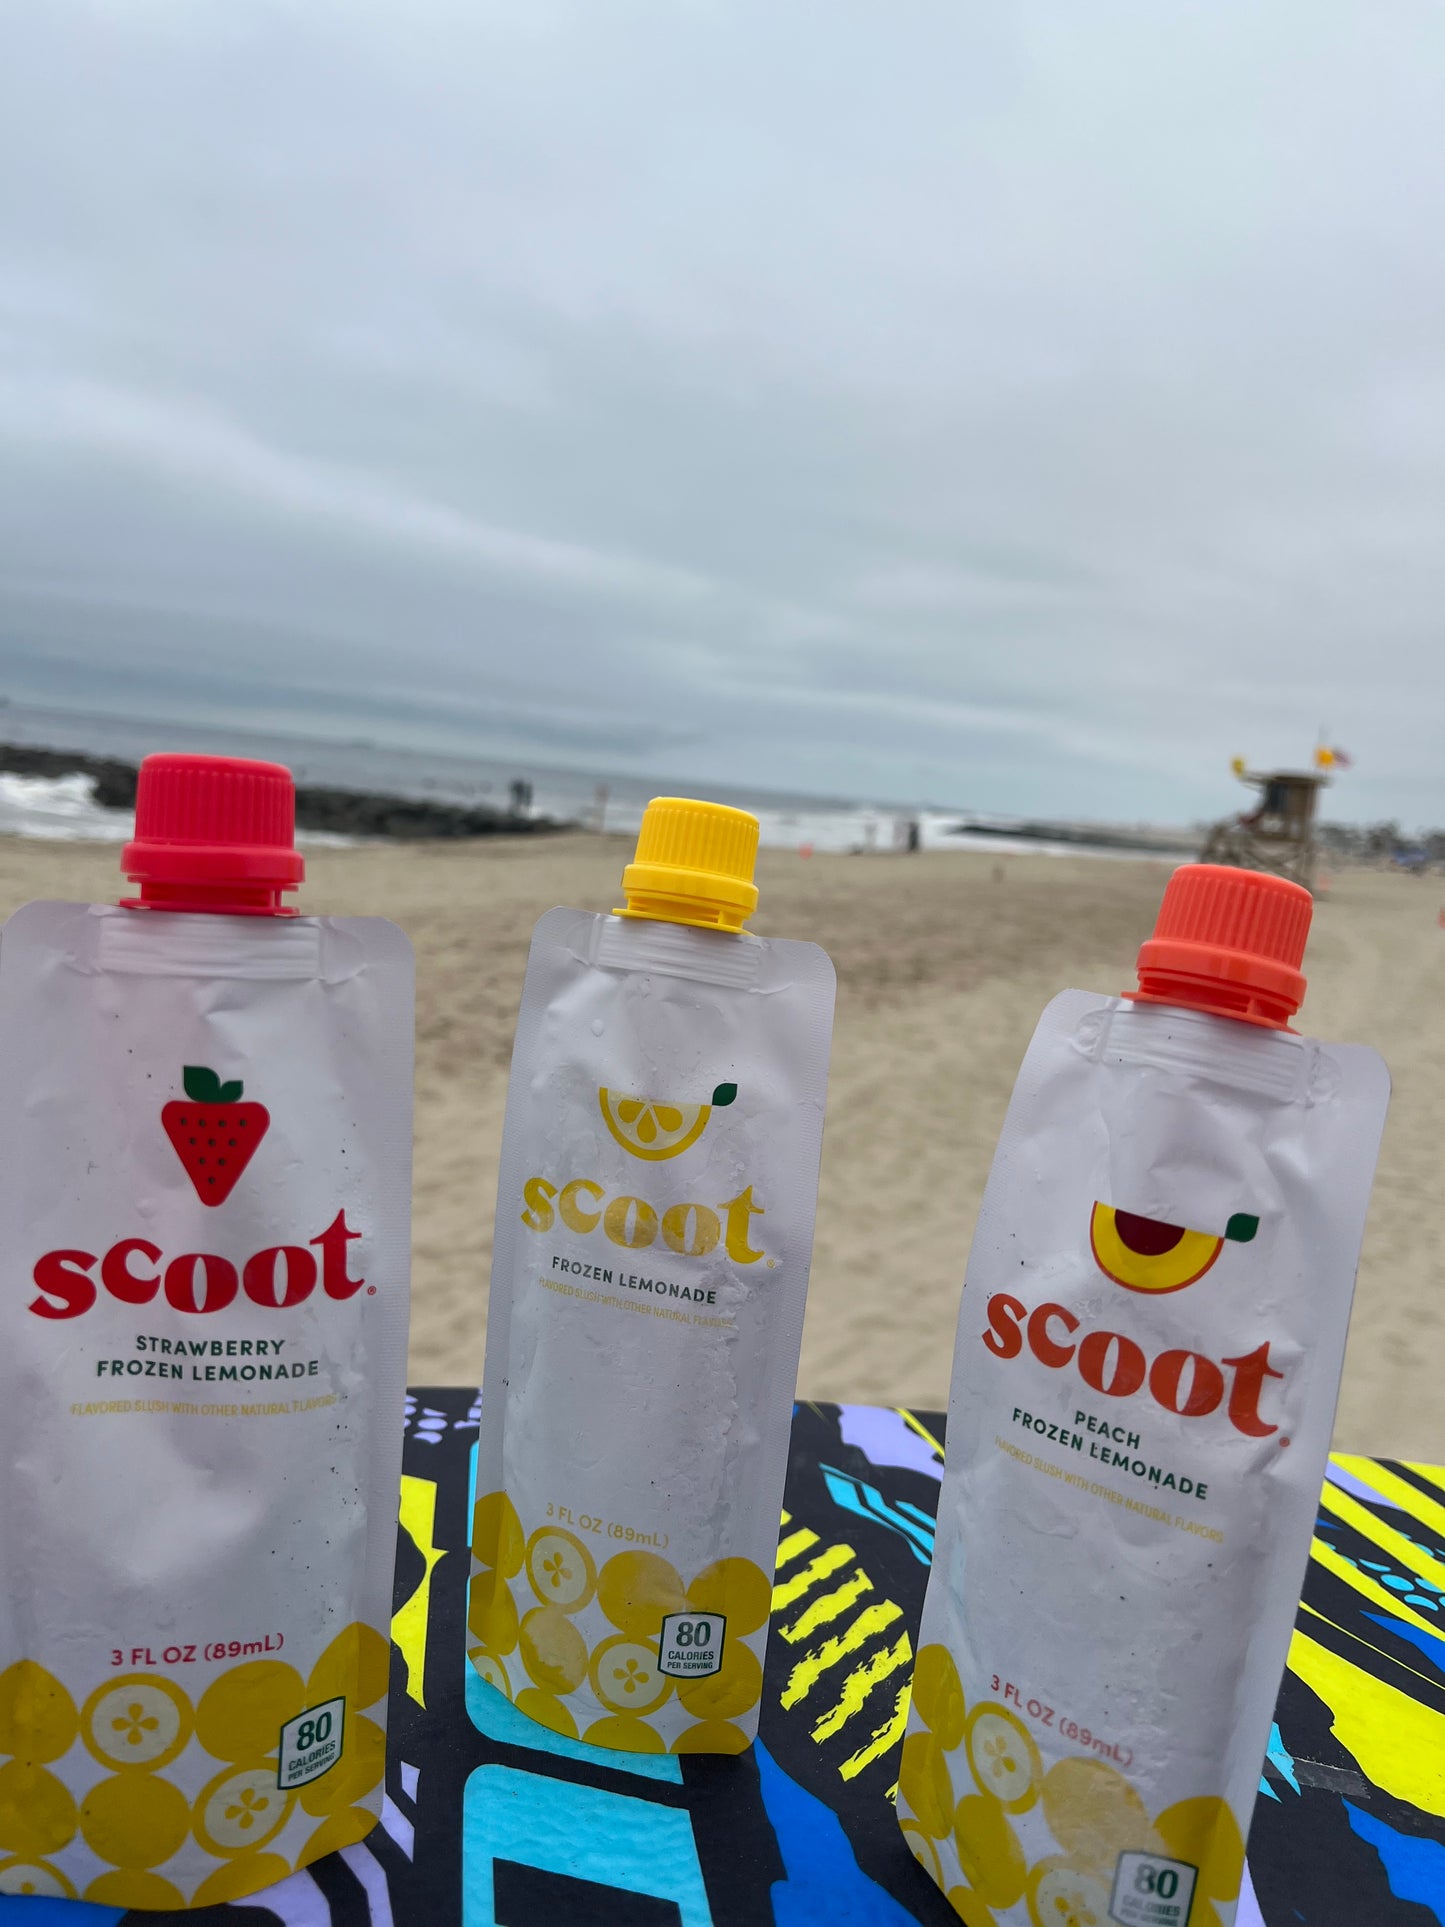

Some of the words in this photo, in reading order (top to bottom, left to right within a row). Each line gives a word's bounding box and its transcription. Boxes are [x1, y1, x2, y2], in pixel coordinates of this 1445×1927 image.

[551, 1256, 613, 1284] FROZEN
[619, 1269, 717, 1304] LEMONADE
[538, 1276, 574, 1296] FLAVORED
[575, 1287, 600, 1303] SLUSH
[602, 1295, 622, 1308] WITH
[623, 1300, 650, 1314] OTHER
[653, 1306, 691, 1325] NATURAL
[136, 1335, 286, 1357] STRAWBERRY
[97, 1359, 184, 1380] FROZEN
[192, 1359, 319, 1381] LEMONADE
[71, 1400, 132, 1416] FLAVORED
[134, 1399, 169, 1412] SLUSH
[172, 1401, 198, 1415] WITH
[200, 1403, 238, 1417] OTHER
[240, 1402, 290, 1417] NATURAL
[1074, 1410, 1141, 1449] PEACH
[1012, 1407, 1084, 1452] FROZEN
[1089, 1442, 1208, 1500] LEMONADE
[995, 1435, 1033, 1465] FLAVORED
[1033, 1457, 1063, 1479] SLUSH
[1064, 1471, 1089, 1490] WITH
[1090, 1482, 1124, 1505] OTHER
[1125, 1497, 1172, 1526] NATURAL
[1174, 1516, 1224, 1544] FLAVORS
[546, 1502, 554, 1517] 3
[558, 1506, 574, 1525] FL
[579, 1514, 602, 1534] OZ
[607, 1522, 669, 1549] (89mL)
[111, 1649, 123, 1666] 3
[131, 1648, 156, 1666] FL
[163, 1645, 197, 1663] OZ
[204, 1633, 284, 1662] (89mL)
[676, 1621, 711, 1647] 80
[667, 1661, 681, 1669] PER
[683, 1661, 713, 1670] SERVING
[668, 1650, 714, 1660] CALORIES
[296, 1711, 332, 1751] 80
[990, 1674, 1000, 1692] 3
[1004, 1682, 1022, 1708] FL
[1026, 1699, 1055, 1727] OZ
[1059, 1717, 1133, 1768] (89mL)
[287, 1769, 303, 1781] PER
[304, 1753, 335, 1774] SERVING
[288, 1740, 336, 1771] CALORIES
[1134, 1863, 1179, 1899] 80
